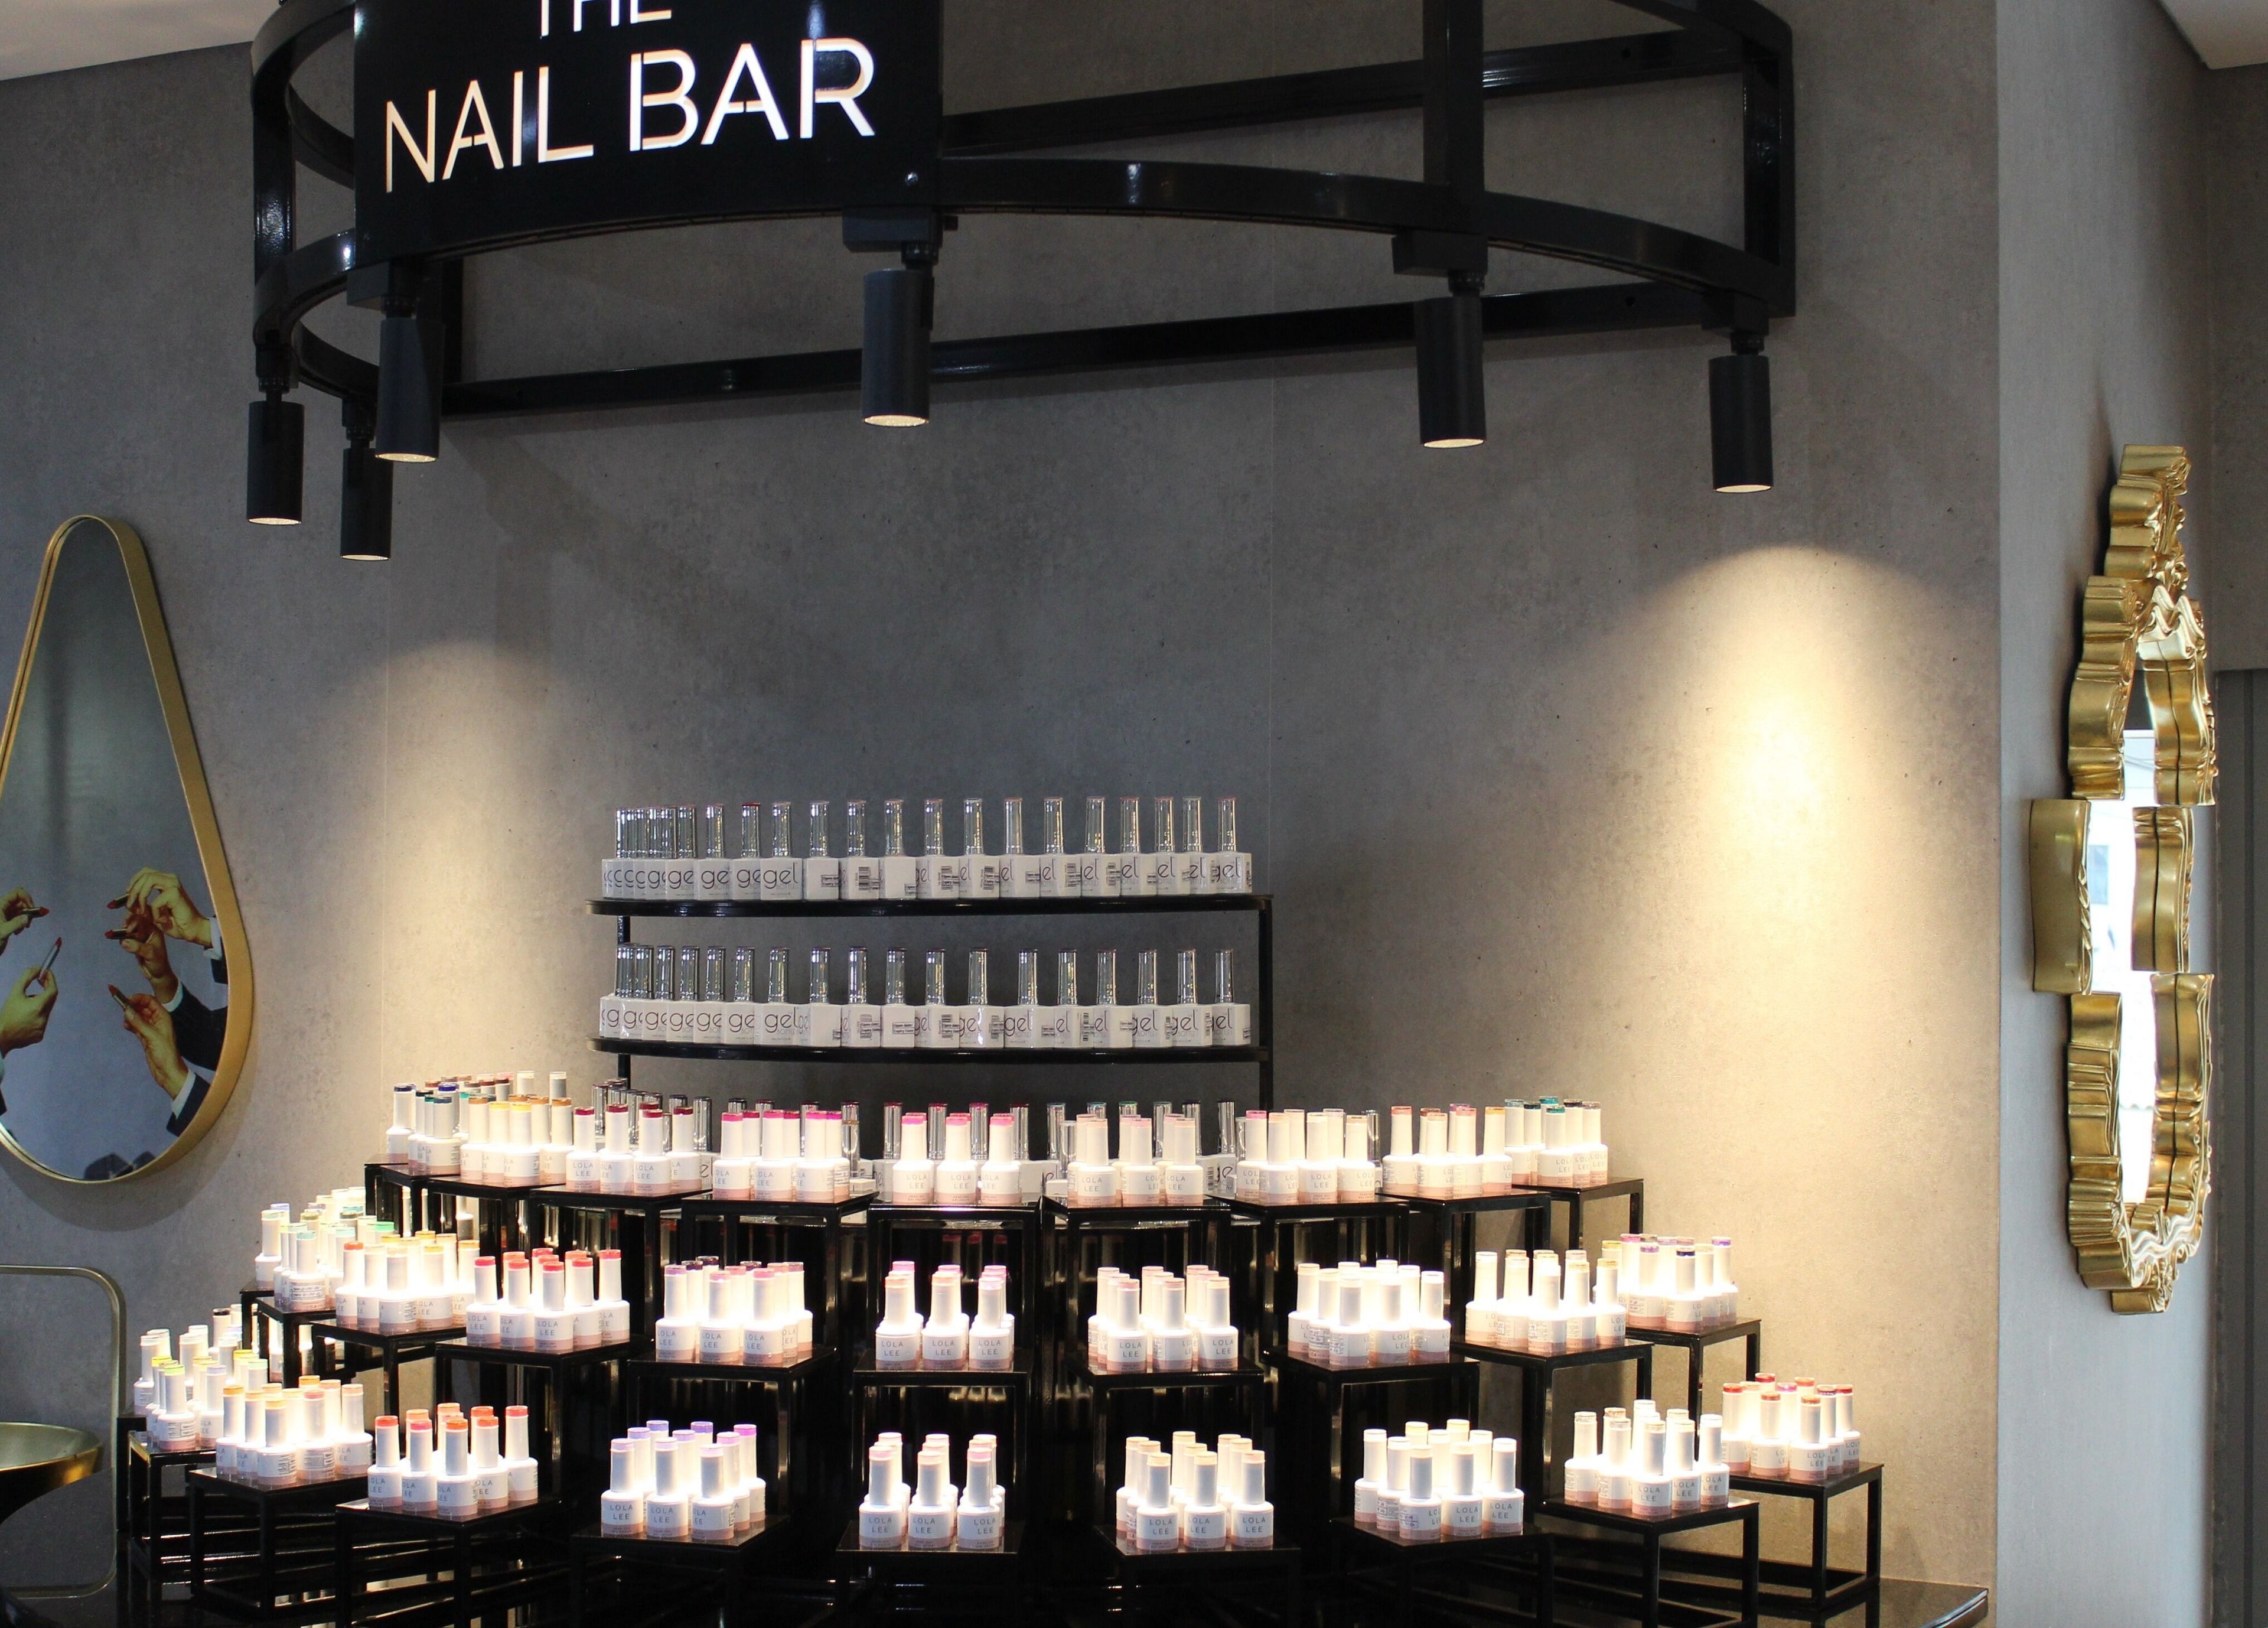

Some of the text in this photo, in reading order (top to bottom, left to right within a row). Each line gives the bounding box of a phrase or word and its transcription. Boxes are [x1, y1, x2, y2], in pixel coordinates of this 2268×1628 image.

[386, 38, 875, 191] NAIL BAR
[763, 862, 799, 889] gel
[960, 859, 971, 881] el
[1001, 859, 1014, 881] el
[1042, 858, 1057, 881] el
[1084, 858, 1099, 880] el
[1122, 857, 1139, 878] el
[1158, 857, 1176, 878] el
[1190, 857, 1205, 878] el
[668, 871, 693, 889] ge
[701, 871, 729, 889] ge
[737, 869, 761, 888] ge
[645, 1012, 667, 1031] ge
[669, 1012, 695, 1031] ge
[696, 1012, 722, 1032] ge
[728, 1014, 755, 1033] ge
[764, 1006, 798, 1033] gel
[842, 1009, 851, 1032] el
[1004, 1010, 1031, 1037] gel
[1055, 1010, 1070, 1033] el
[1094, 1010, 1109, 1032] el
[1212, 1008, 1233, 1032] el
[700, 1157, 713, 1178] el
[973, 1517, 996, 1525] LOLA
